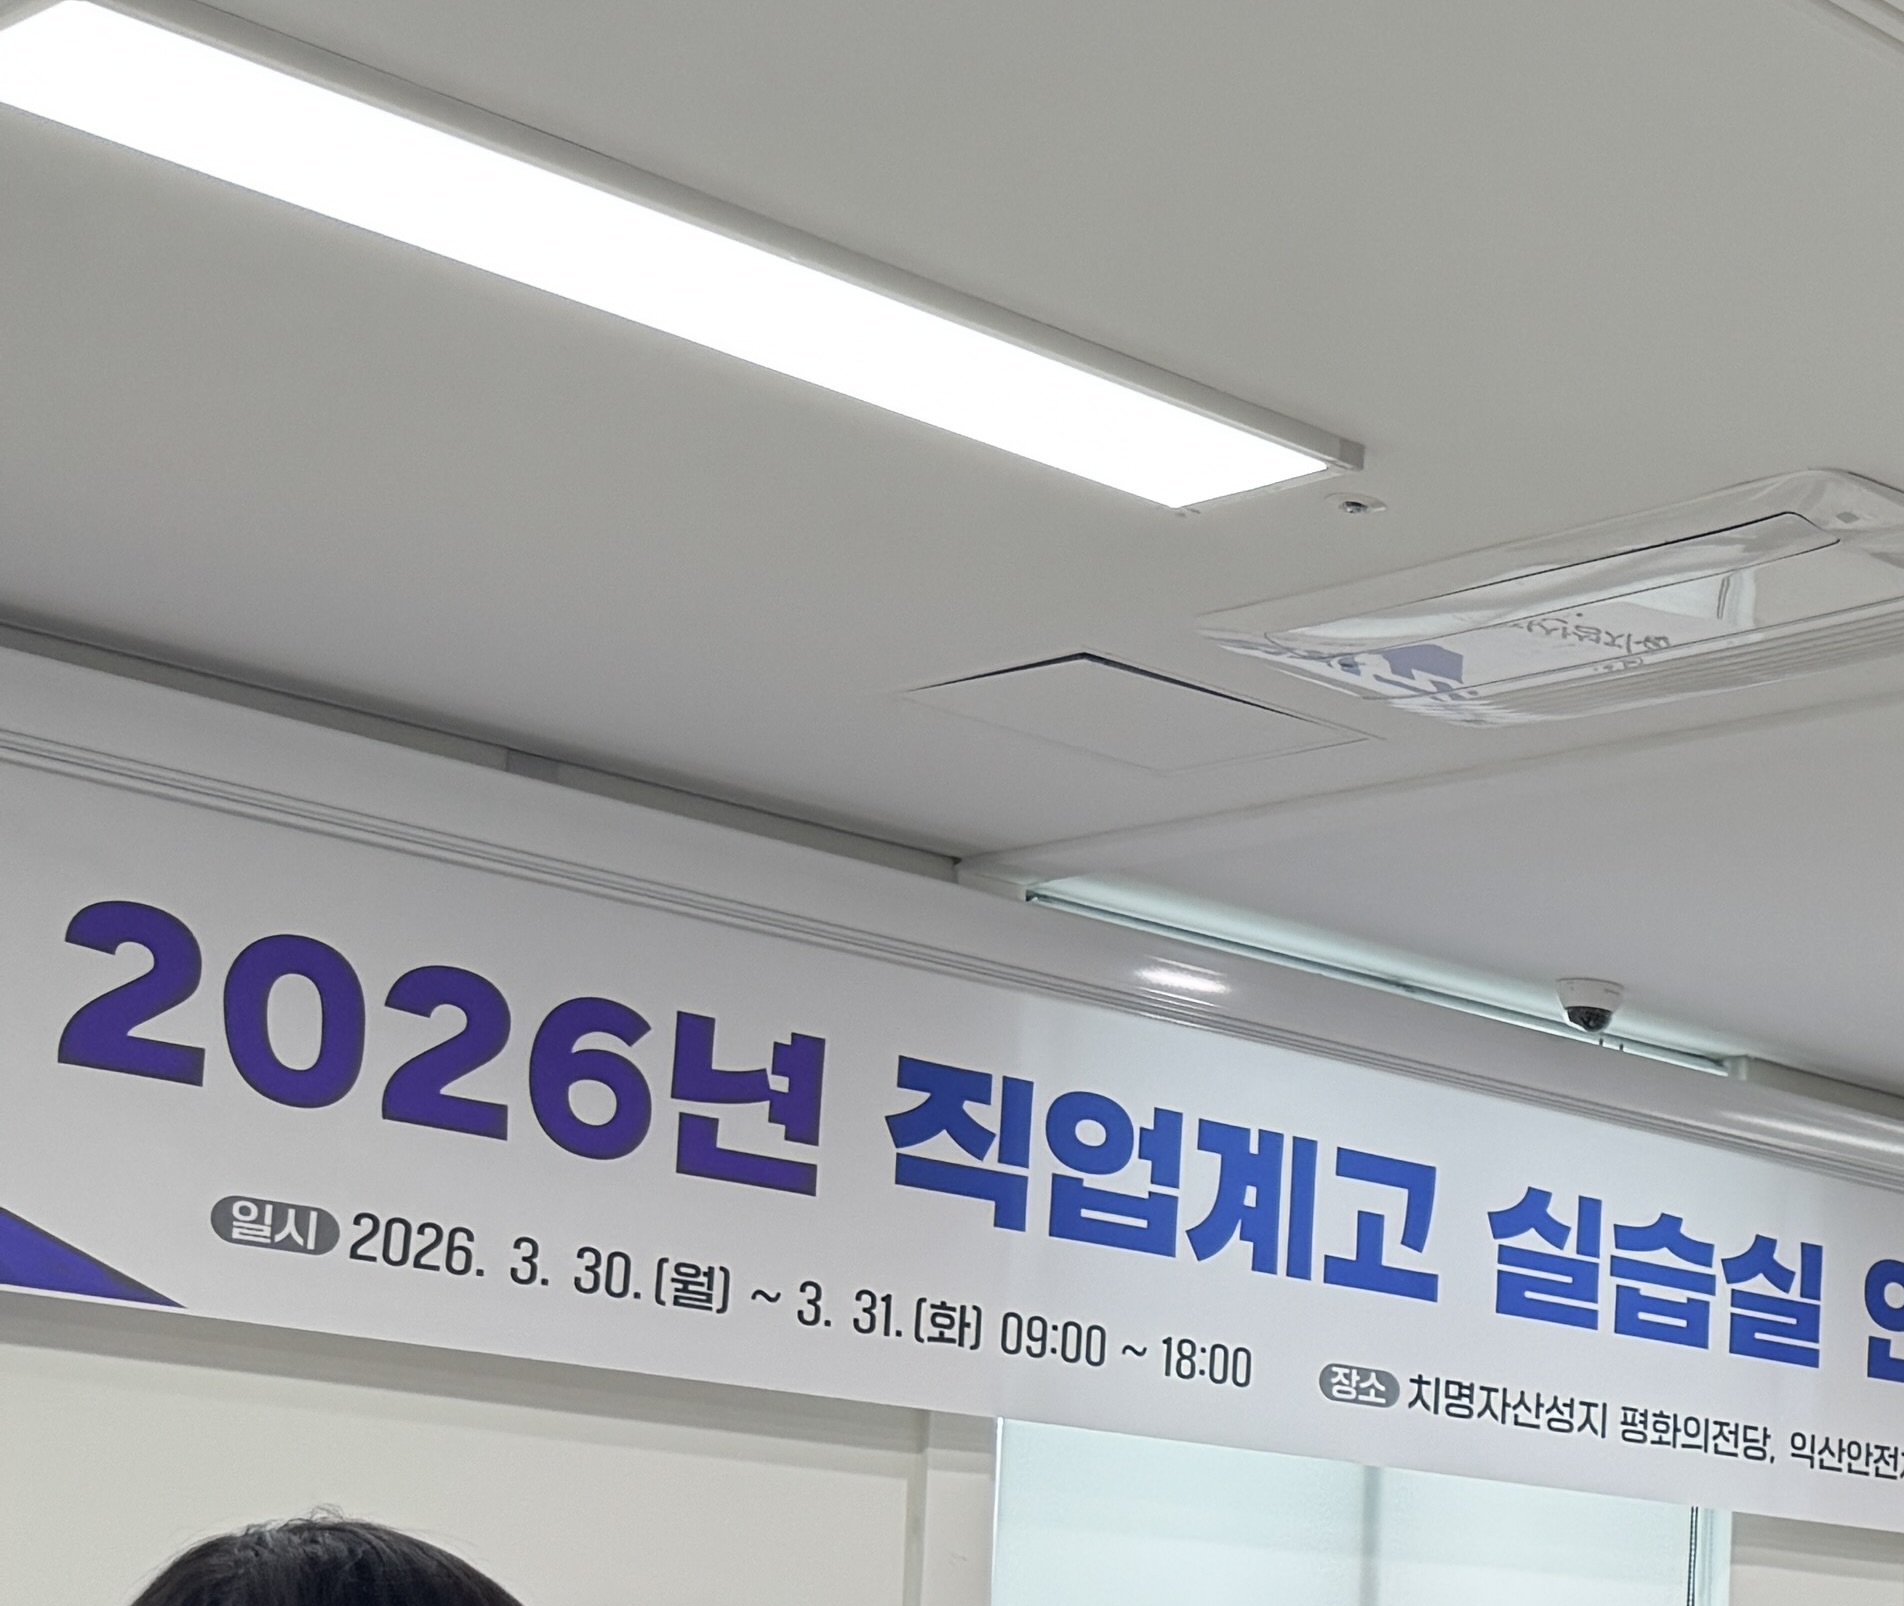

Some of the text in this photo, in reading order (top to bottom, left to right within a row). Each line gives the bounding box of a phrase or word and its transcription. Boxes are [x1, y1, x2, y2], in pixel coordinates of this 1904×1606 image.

[58, 901, 825, 1196] 2026년
[885, 1055, 1438, 1303] 직업계고
[1488, 1187, 1823, 1368] 실습실
[231, 1200, 318, 1250] 일시
[350, 1213, 484, 1276] 2026.
[511, 1237, 548, 1286] 3.
[751, 1290, 781, 1302] ~
[797, 1281, 831, 1327] 3.
[1001, 1312, 1106, 1366] 09:00
[1122, 1345, 1147, 1356] ~
[1162, 1337, 1251, 1387] 18:00
[1330, 1366, 1387, 1404] 장소
[1408, 1374, 1607, 1438] 치명자산성지
[1620, 1406, 1775, 1464] 평화의전당,
